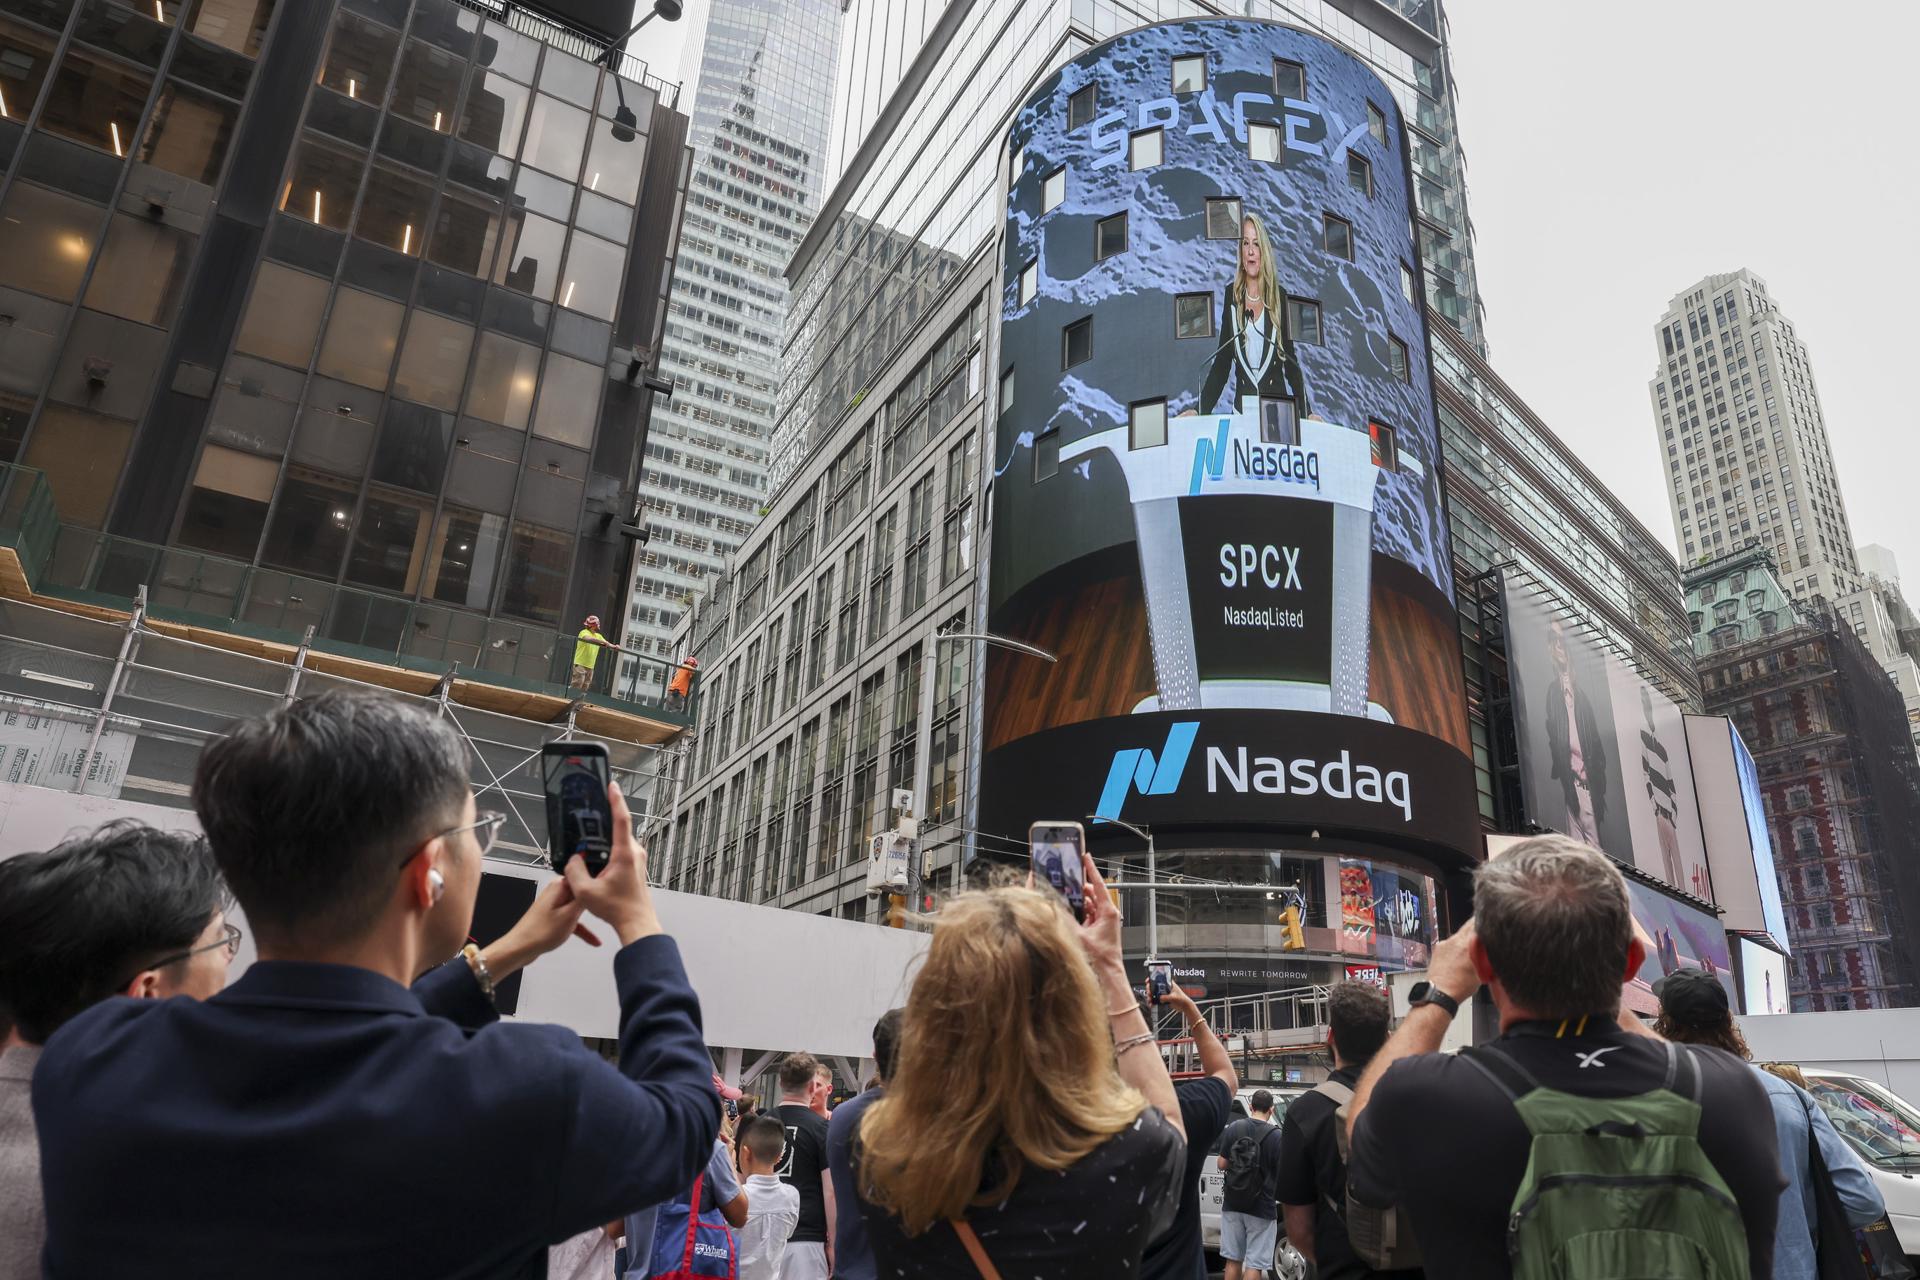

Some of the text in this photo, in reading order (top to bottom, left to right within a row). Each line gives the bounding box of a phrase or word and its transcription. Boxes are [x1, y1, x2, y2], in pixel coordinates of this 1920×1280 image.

[1091, 91, 1394, 170] SPACEX
[1234, 438, 1320, 491] Nasdaq
[1219, 543, 1303, 591] SPCX
[1224, 606, 1304, 629] NasdaqListed
[1207, 746, 1412, 822] Nasdaq
[1173, 968, 1308, 979] Nasdaq REWRITE TOMORROW
